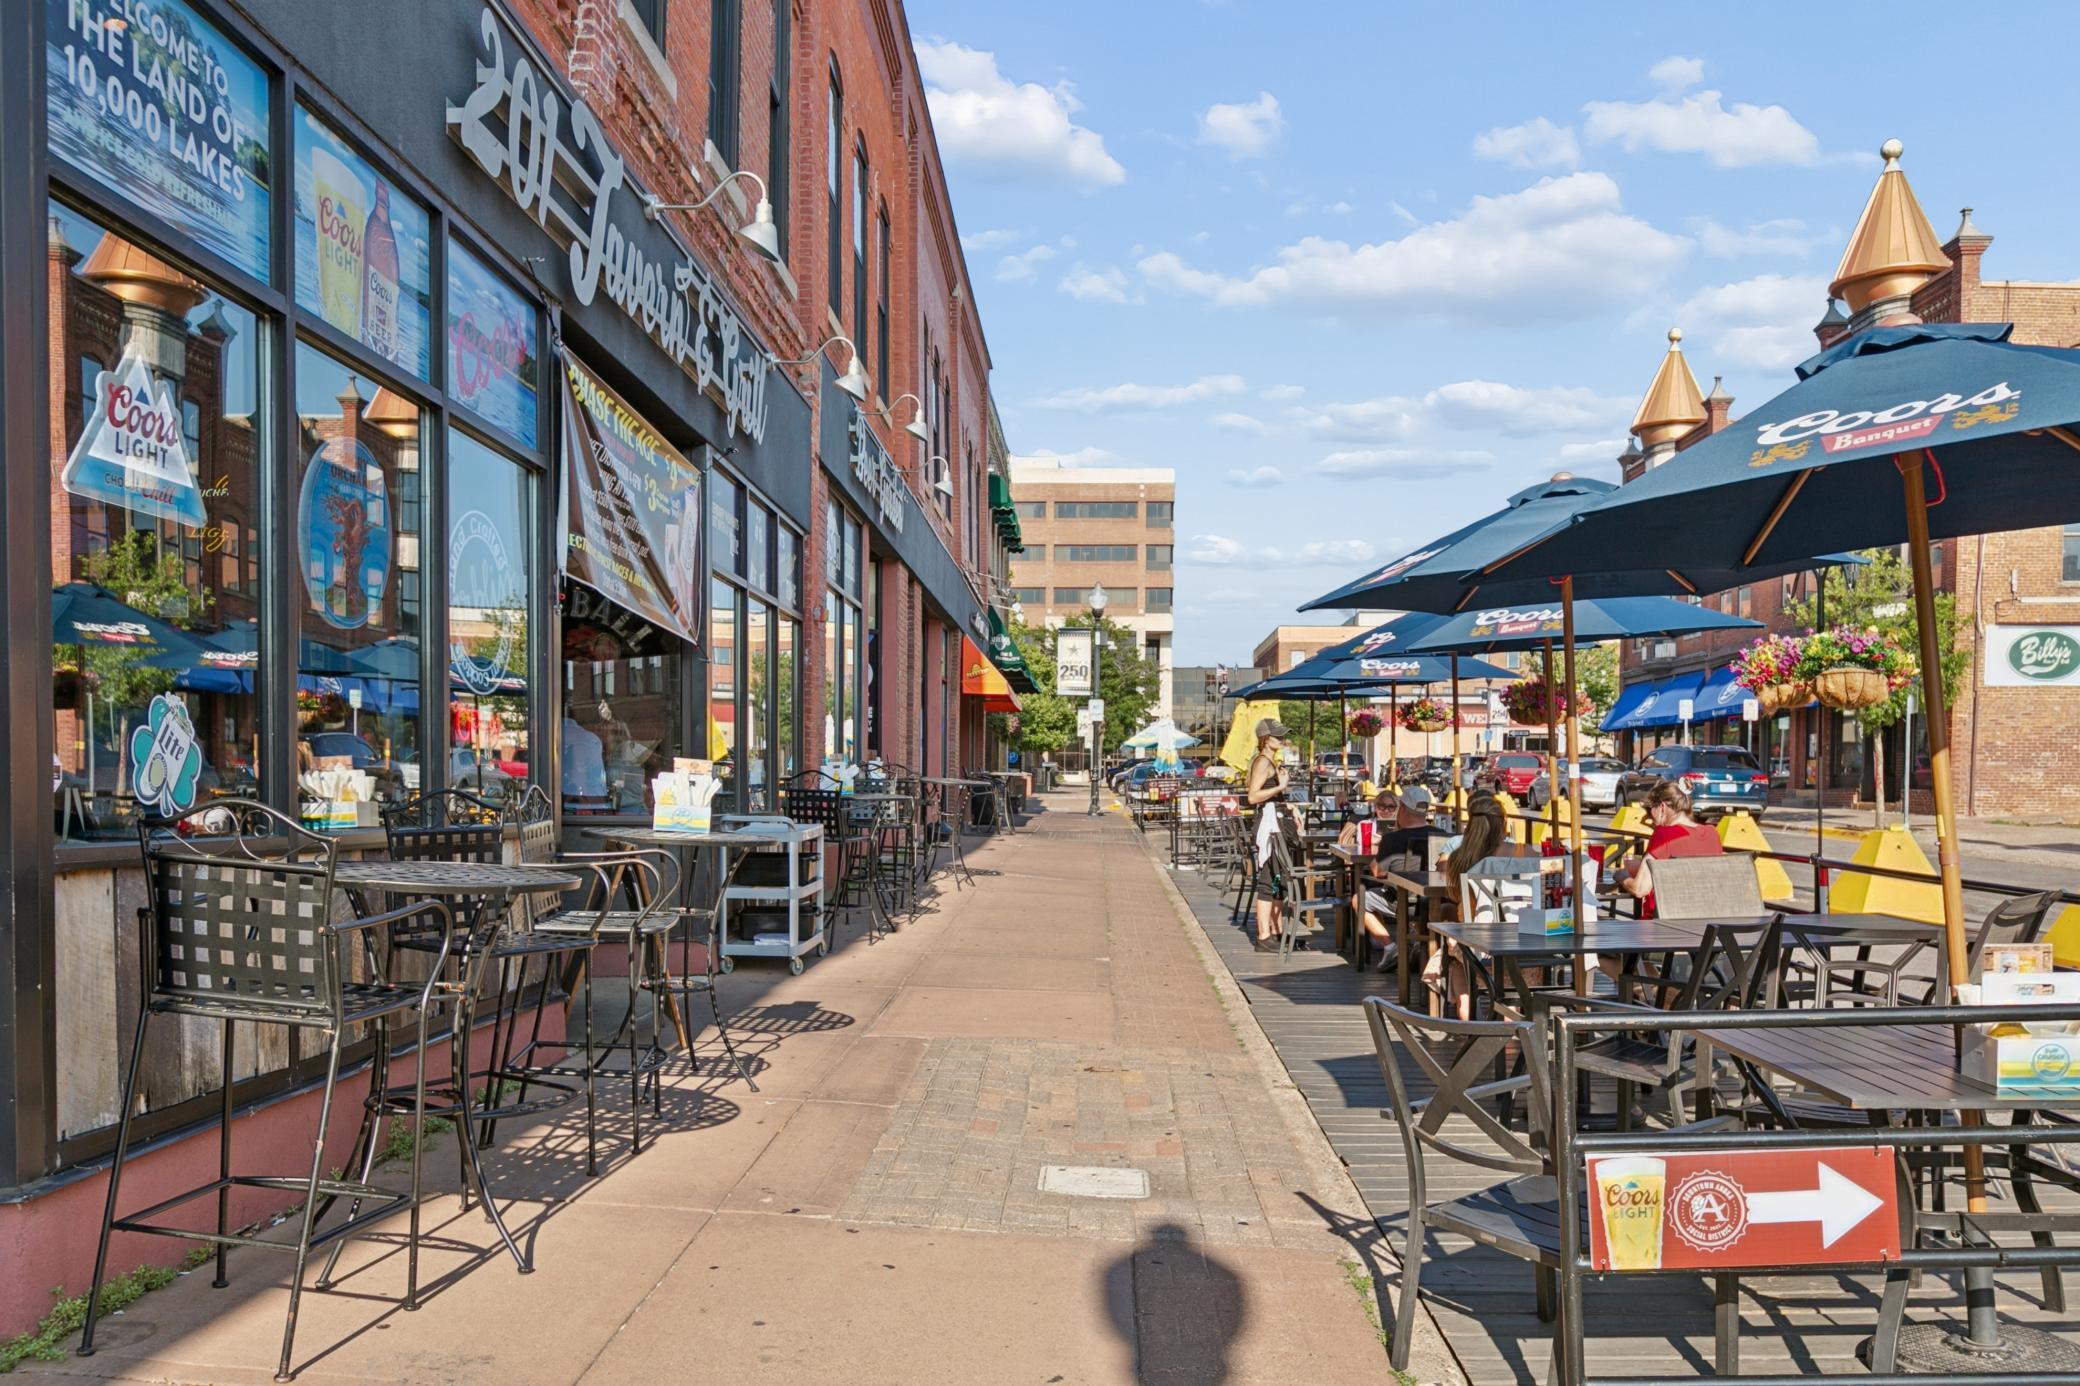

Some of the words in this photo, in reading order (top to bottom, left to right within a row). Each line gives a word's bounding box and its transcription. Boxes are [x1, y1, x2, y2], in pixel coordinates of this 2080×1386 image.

[109, 0, 198, 74] LCOME
[203, 55, 229, 96] TO
[68, 0, 124, 67] THE
[132, 39, 206, 124] LAND
[212, 105, 245, 152] OF
[64, 44, 161, 143] 10,000
[169, 118, 245, 201] LAKES
[319, 194, 362, 257] Coors
[460, 7, 558, 226] 201
[569, 100, 689, 364] Tavern
[718, 303, 768, 445] Grill
[324, 241, 359, 278] LIGHT
[370, 272, 393, 305] Coors
[107, 382, 178, 447] Coors
[1757, 382, 2018, 446] Coors
[115, 431, 169, 470] LIGHT
[1831, 417, 1934, 451] Banquet
[1060, 664, 1089, 679] 250
[1361, 658, 1421, 670] Coors
[2019, 636, 2072, 675] Billy's
[159, 723, 184, 761] Lite
[1605, 1183, 1660, 1207] Coors
[1613, 1206, 1656, 1219] LIGHT
[1692, 1193, 1730, 1223] A
